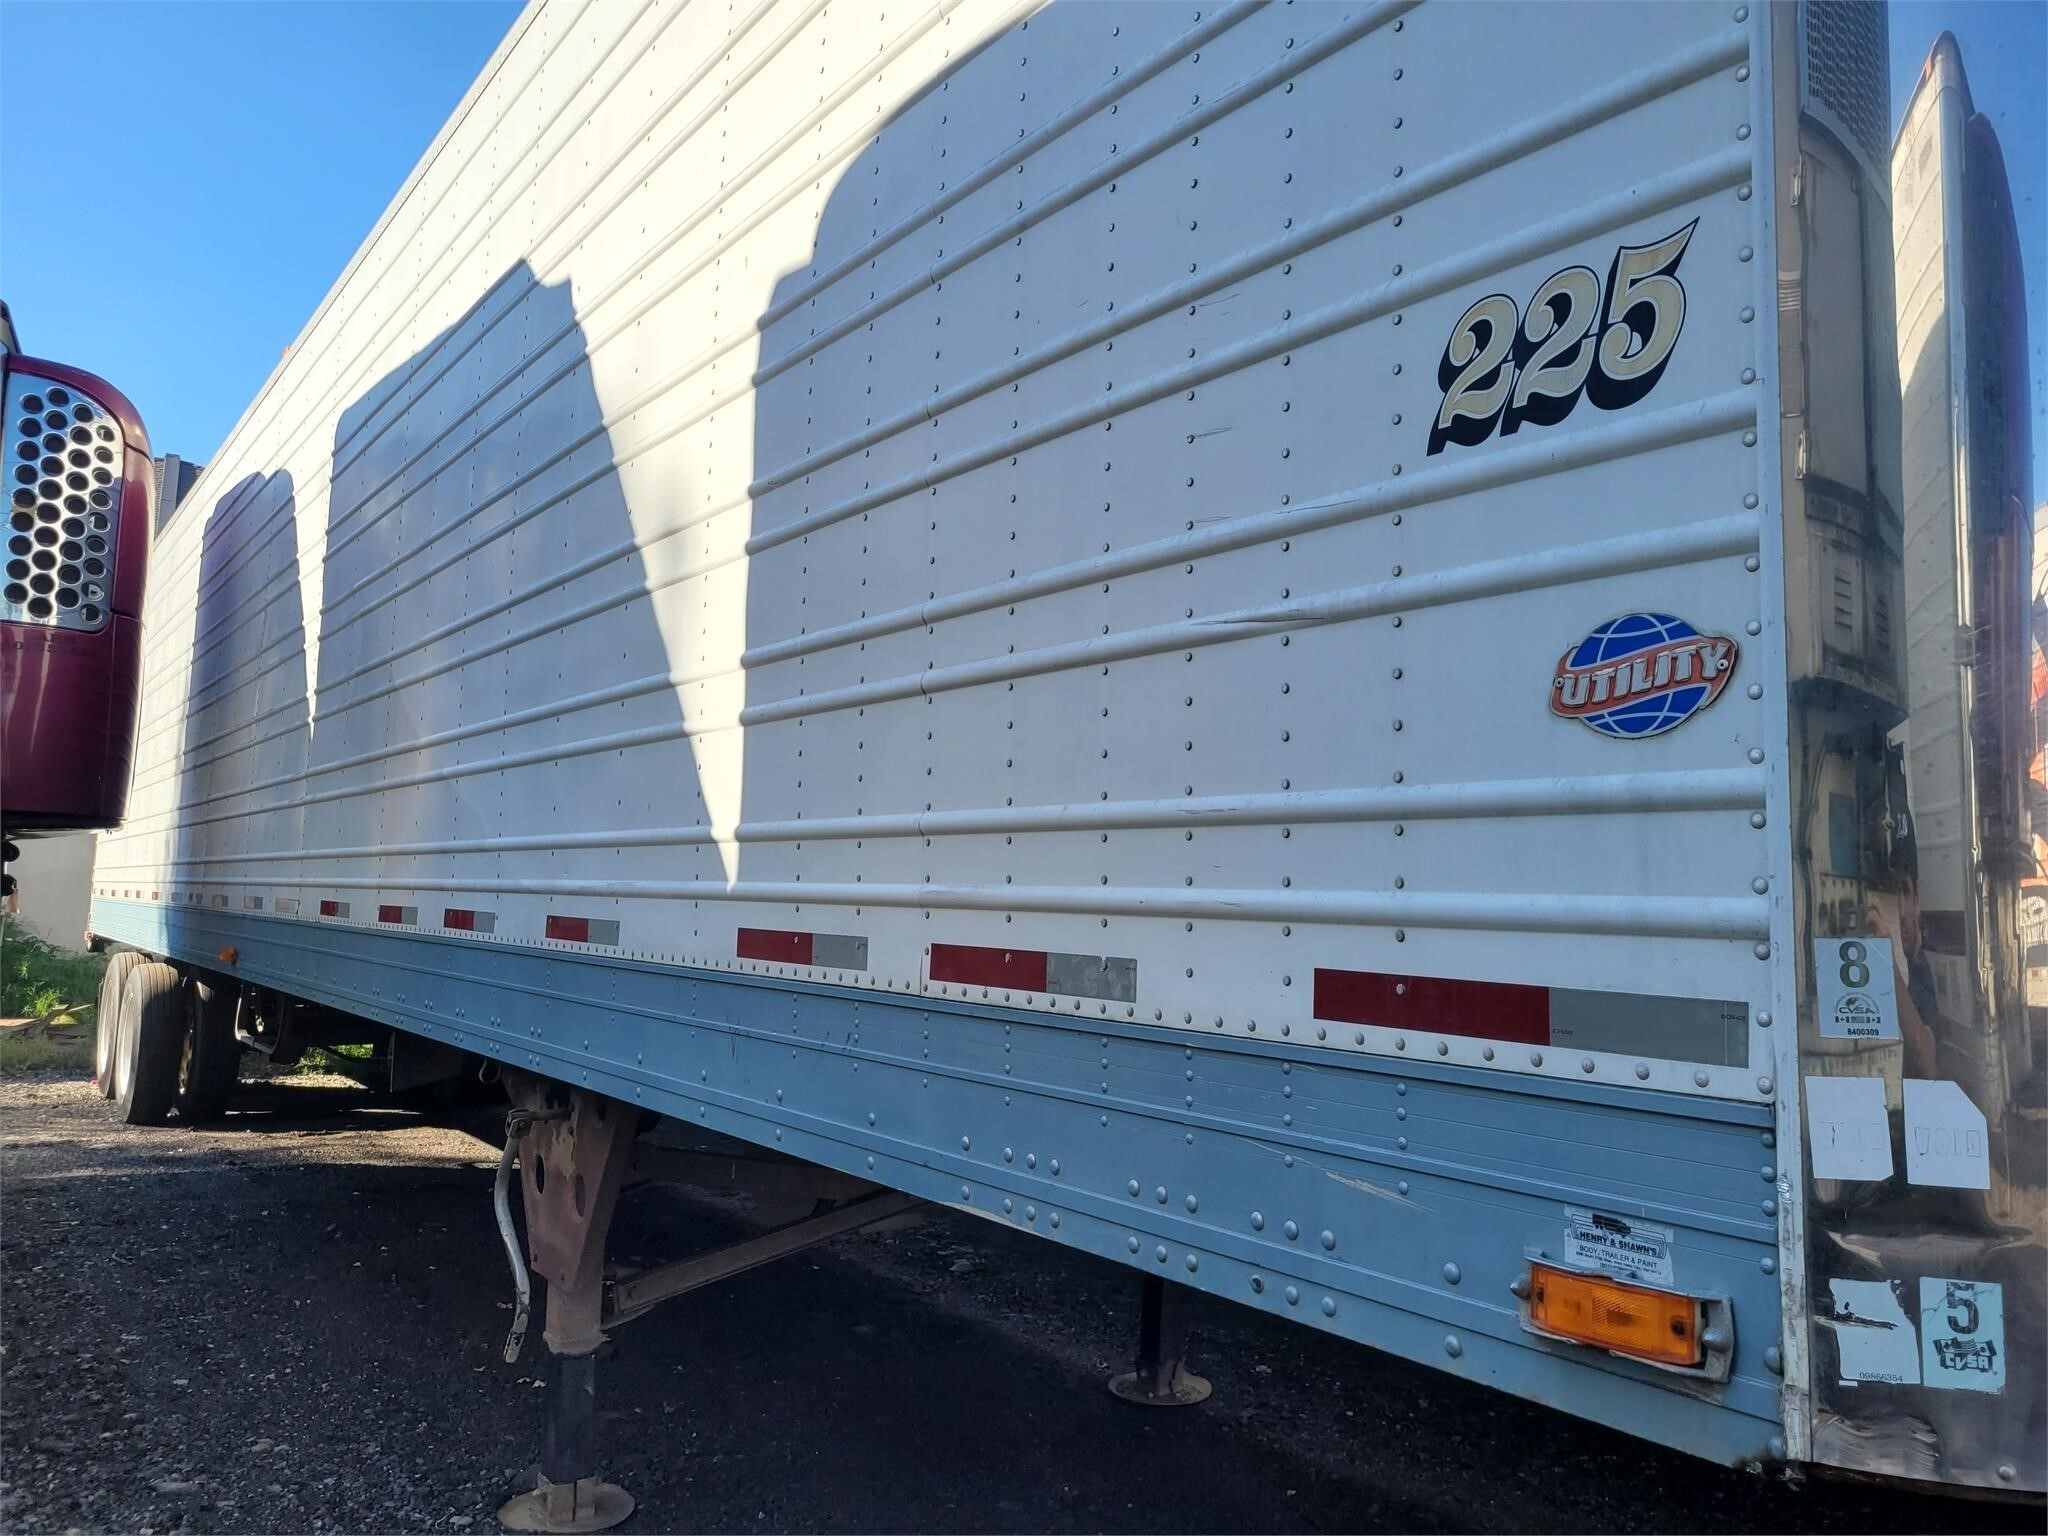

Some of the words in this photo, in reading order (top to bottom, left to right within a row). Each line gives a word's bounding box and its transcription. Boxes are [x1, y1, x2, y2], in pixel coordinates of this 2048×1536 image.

[1426, 216, 1700, 457] 225
[1559, 641, 1732, 708] UTILITY
[1838, 940, 1870, 989] 8
[1838, 1006, 1876, 1015] CVSA
[1579, 1230, 1608, 1247] HENRY
[1610, 1237, 1617, 1247] &
[1618, 1239, 1658, 1256] SHAWN'S
[1601, 1249, 1630, 1262] TRAILER
[1631, 1255, 1637, 1264] &
[1638, 1257, 1658, 1269] PAINT
[1945, 1281, 1980, 1335] 5
[1945, 1354, 1990, 1371] CVSA
[1859, 1371, 1904, 1383] 09866354
